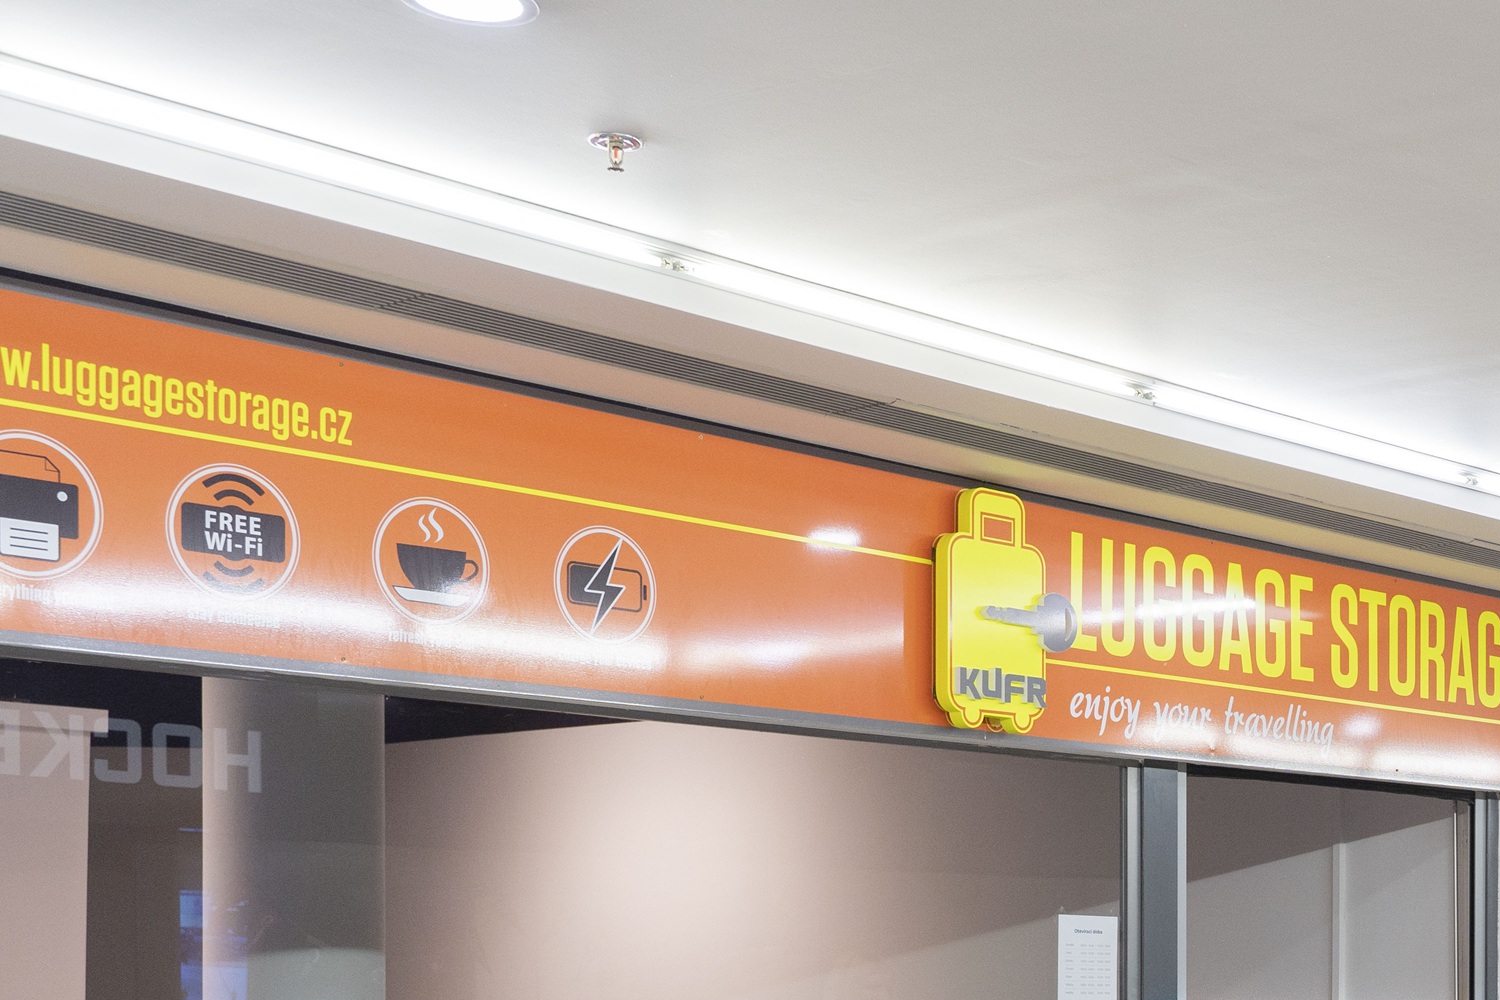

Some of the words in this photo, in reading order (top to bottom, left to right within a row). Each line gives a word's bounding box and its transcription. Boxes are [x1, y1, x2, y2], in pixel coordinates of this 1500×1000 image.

[0, 343, 353, 446] w.luggagestorage.cz
[204, 530, 263, 557] Wi-Fi
[205, 510, 262, 536] FREE
[1070, 531, 1315, 682] LUGGAGE
[955, 666, 1047, 708] KUFR
[1069, 686, 1141, 740] enjoy
[1153, 701, 1212, 742] your
[1224, 696, 1335, 757] travelling
